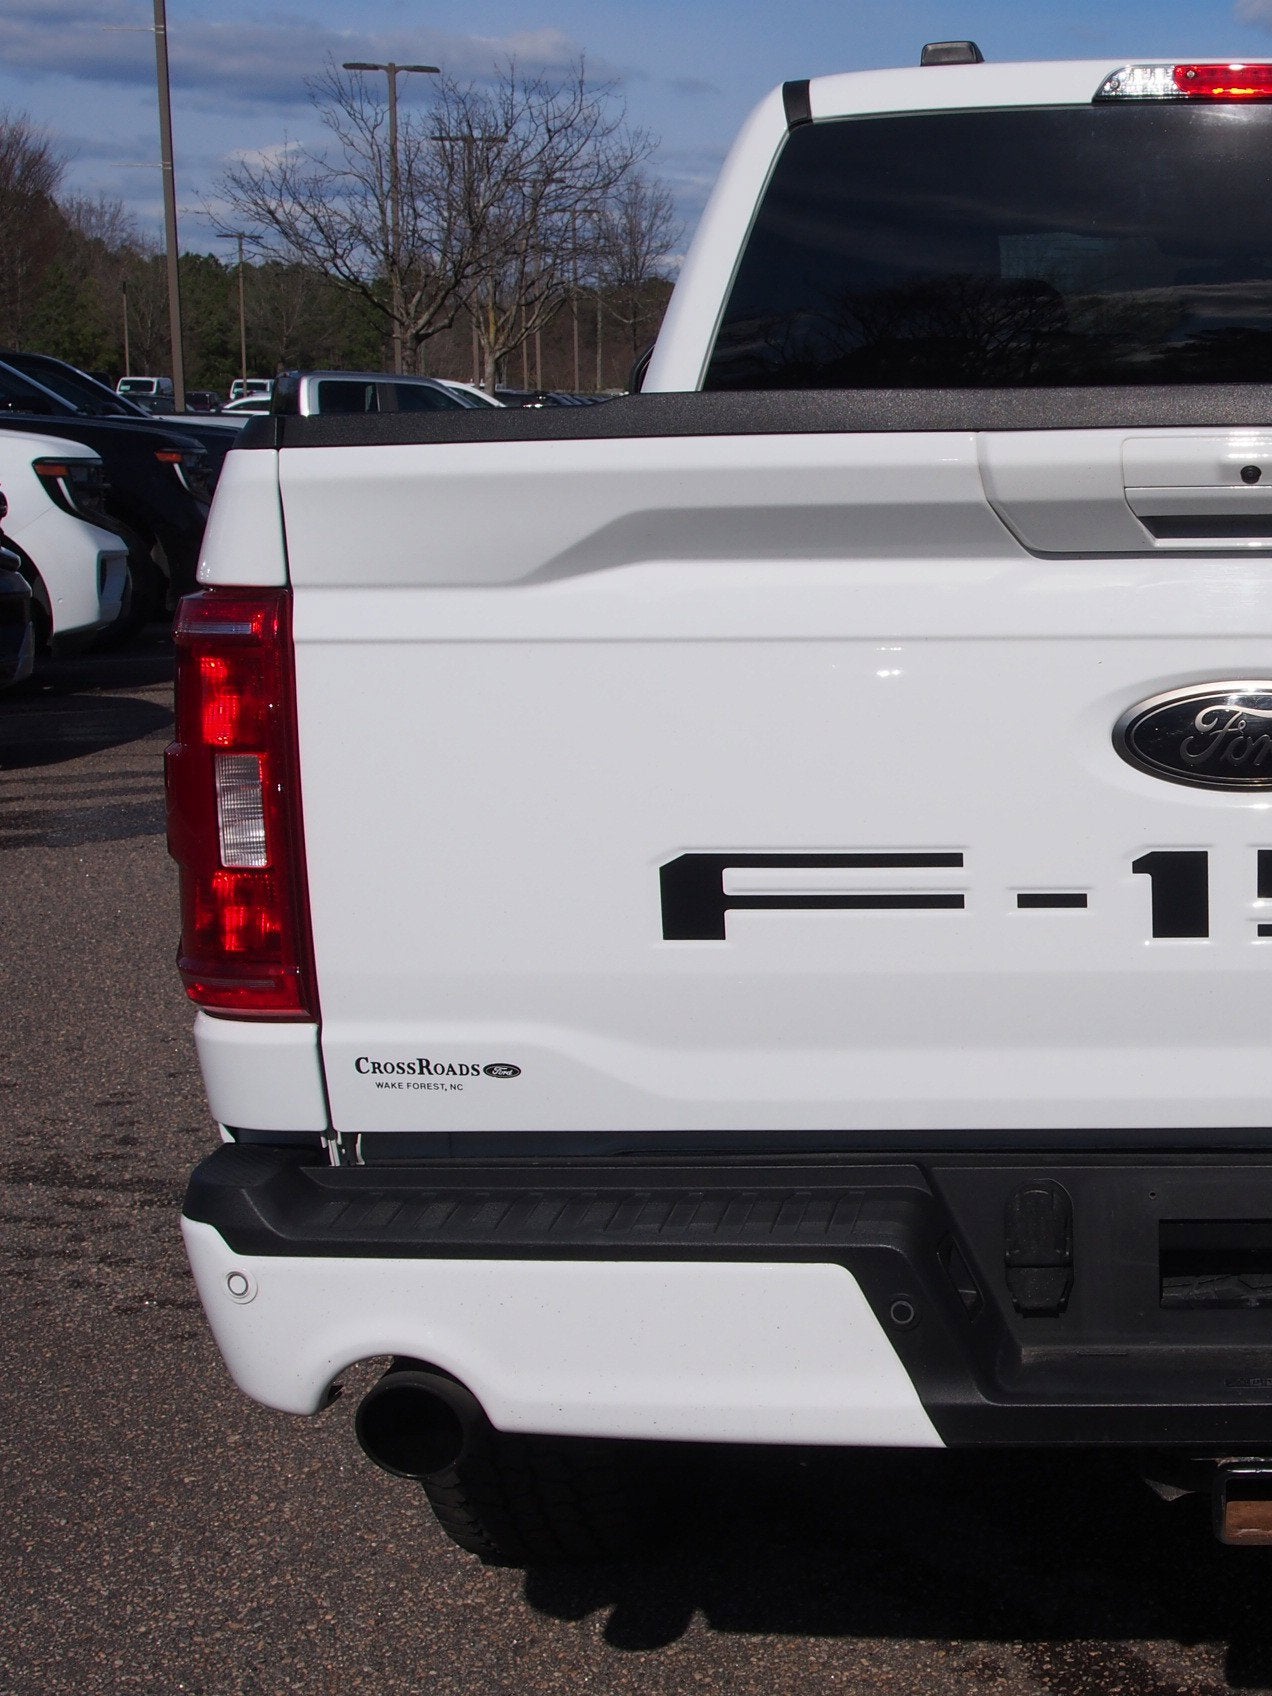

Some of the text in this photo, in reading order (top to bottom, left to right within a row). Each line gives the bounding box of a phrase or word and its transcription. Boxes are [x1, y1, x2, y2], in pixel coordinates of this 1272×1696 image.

[375, 1081, 463, 1091] WAKE FOREST, NC
